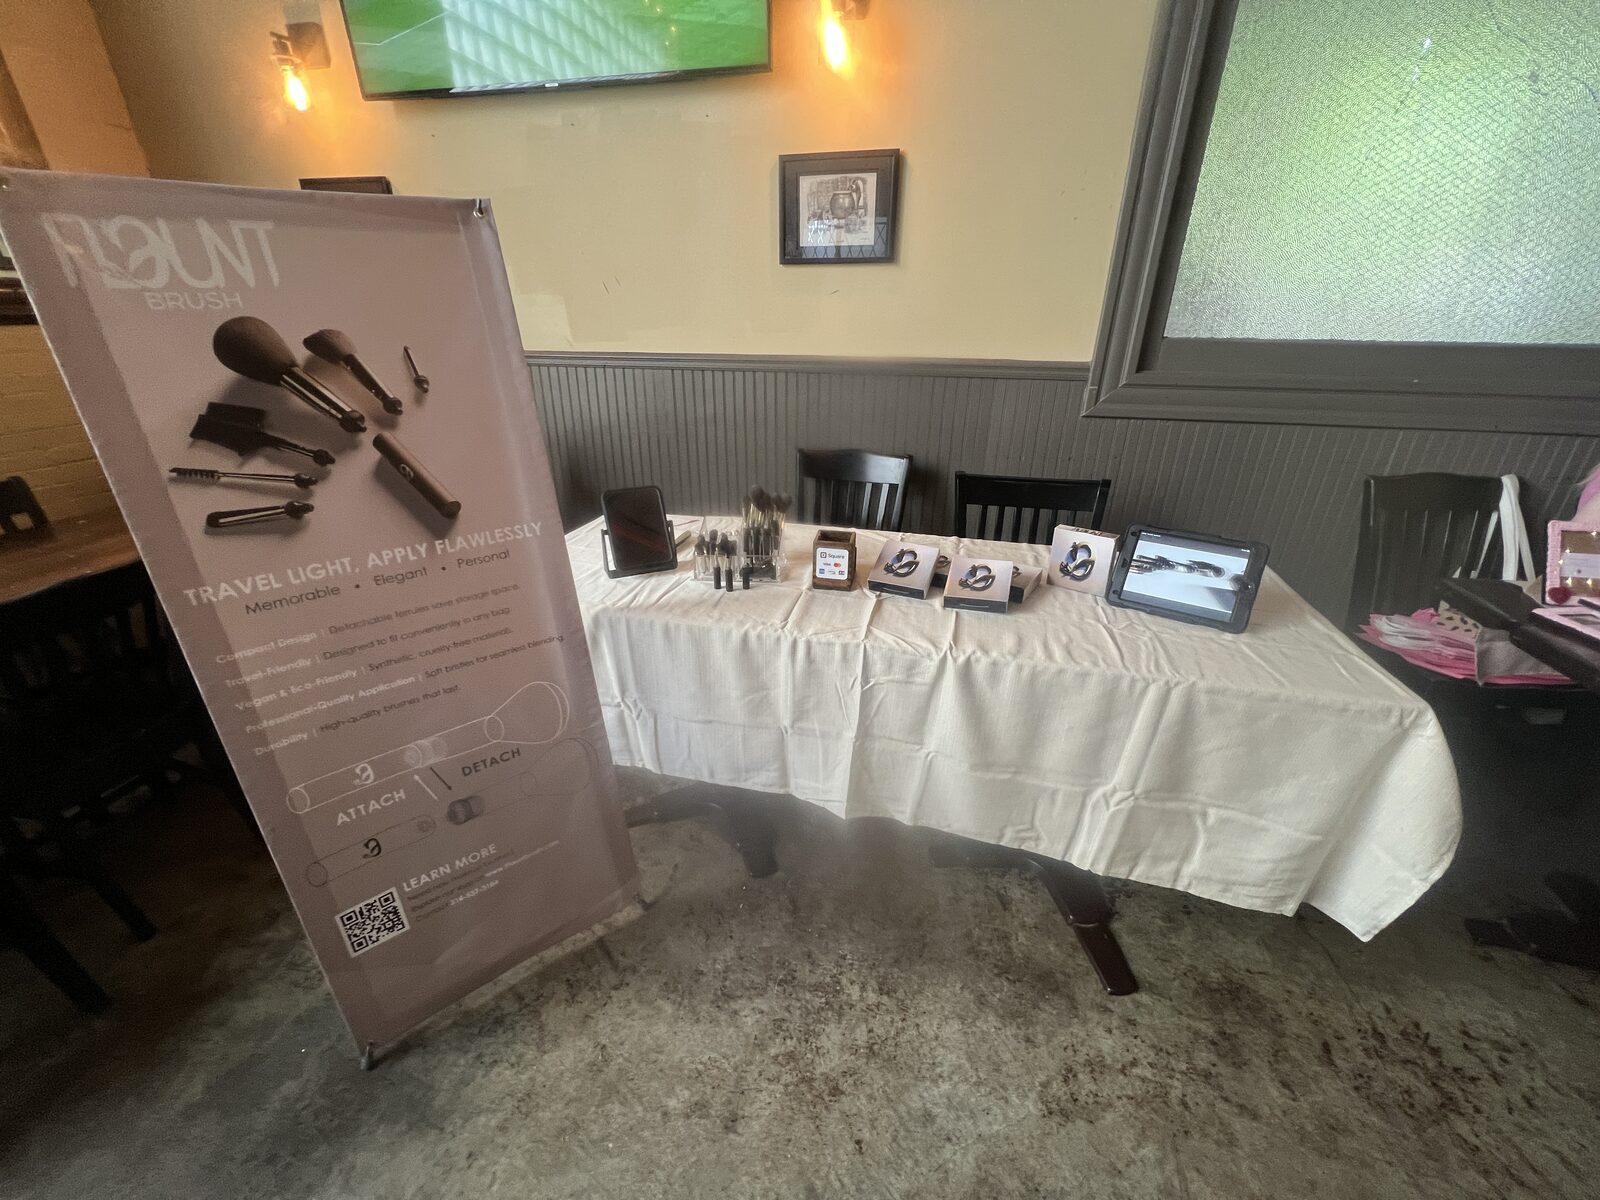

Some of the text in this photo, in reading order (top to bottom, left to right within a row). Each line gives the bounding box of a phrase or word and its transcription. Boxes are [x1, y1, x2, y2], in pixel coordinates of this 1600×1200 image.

[144, 292, 244, 310] BRUSH
[183, 522, 542, 606] TRAVEL LIGHT, APPLY FLAWLESSLY
[828, 552, 845, 560] Square
[245, 550, 511, 615] Memorable Elegant Personal
[216, 641, 276, 664] Compact
[278, 632, 318, 648] Design
[328, 612, 394, 635] Detachable
[323, 641, 375, 661] Designed
[376, 636, 388, 646] to
[389, 634, 398, 643] fit
[400, 619, 461, 640] conveniently
[473, 612, 490, 623] any
[358, 675, 416, 698] Application
[424, 667, 443, 678] Soft
[475, 654, 489, 664] for
[235, 691, 277, 711] Vegan
[255, 731, 309, 756] Durability
[422, 689, 442, 700] that
[461, 748, 522, 777] DETACH
[336, 788, 407, 826] ATTACH
[402, 863, 452, 892] LEARN
[454, 843, 497, 870] MORE
